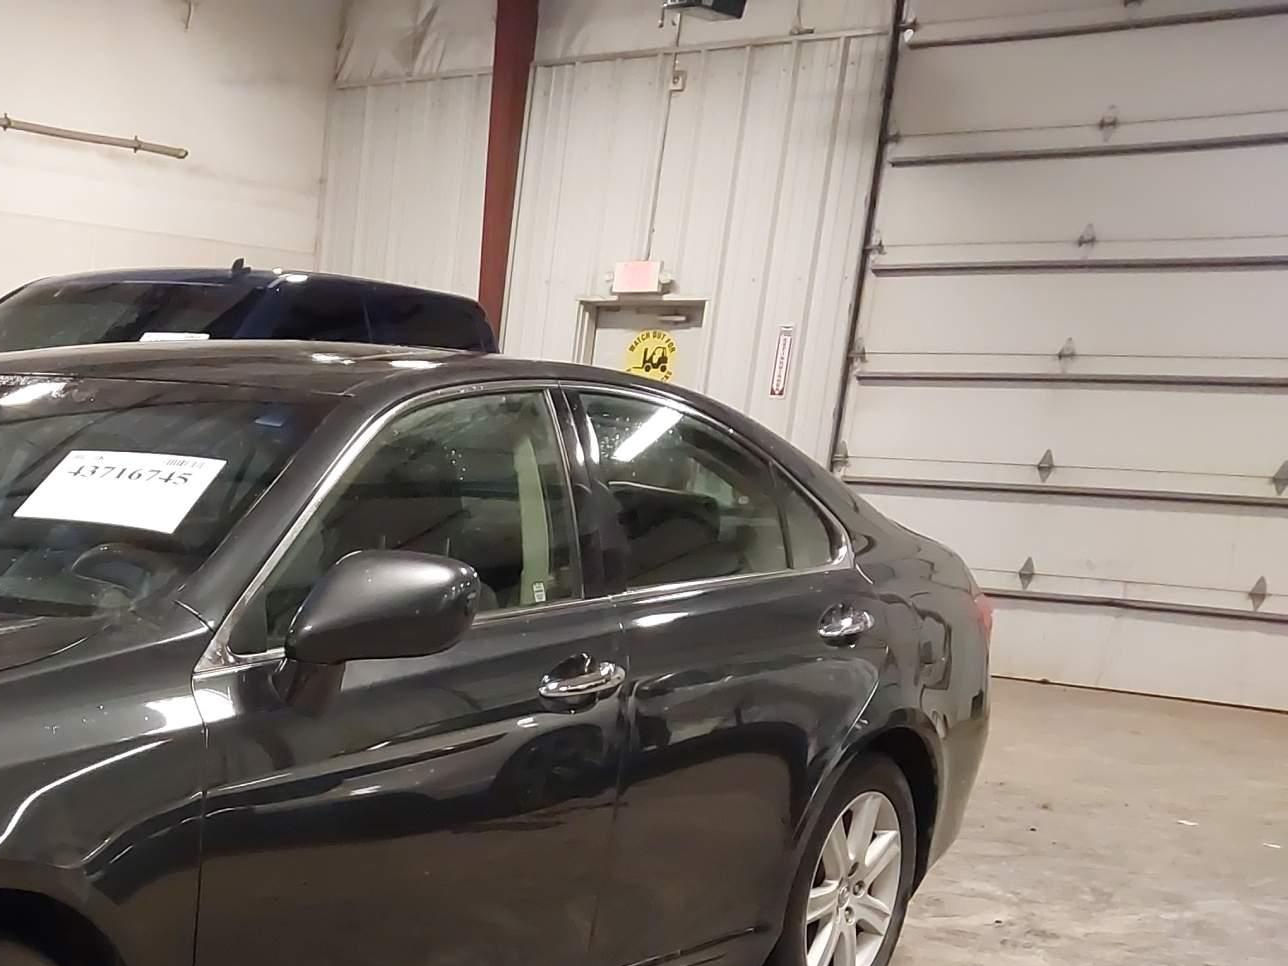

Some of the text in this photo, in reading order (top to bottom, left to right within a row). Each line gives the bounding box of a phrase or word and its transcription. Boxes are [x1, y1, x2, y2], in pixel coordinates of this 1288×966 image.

[628, 330, 676, 353] WATCH OUT FOR
[68, 465, 192, 485] 43716745
